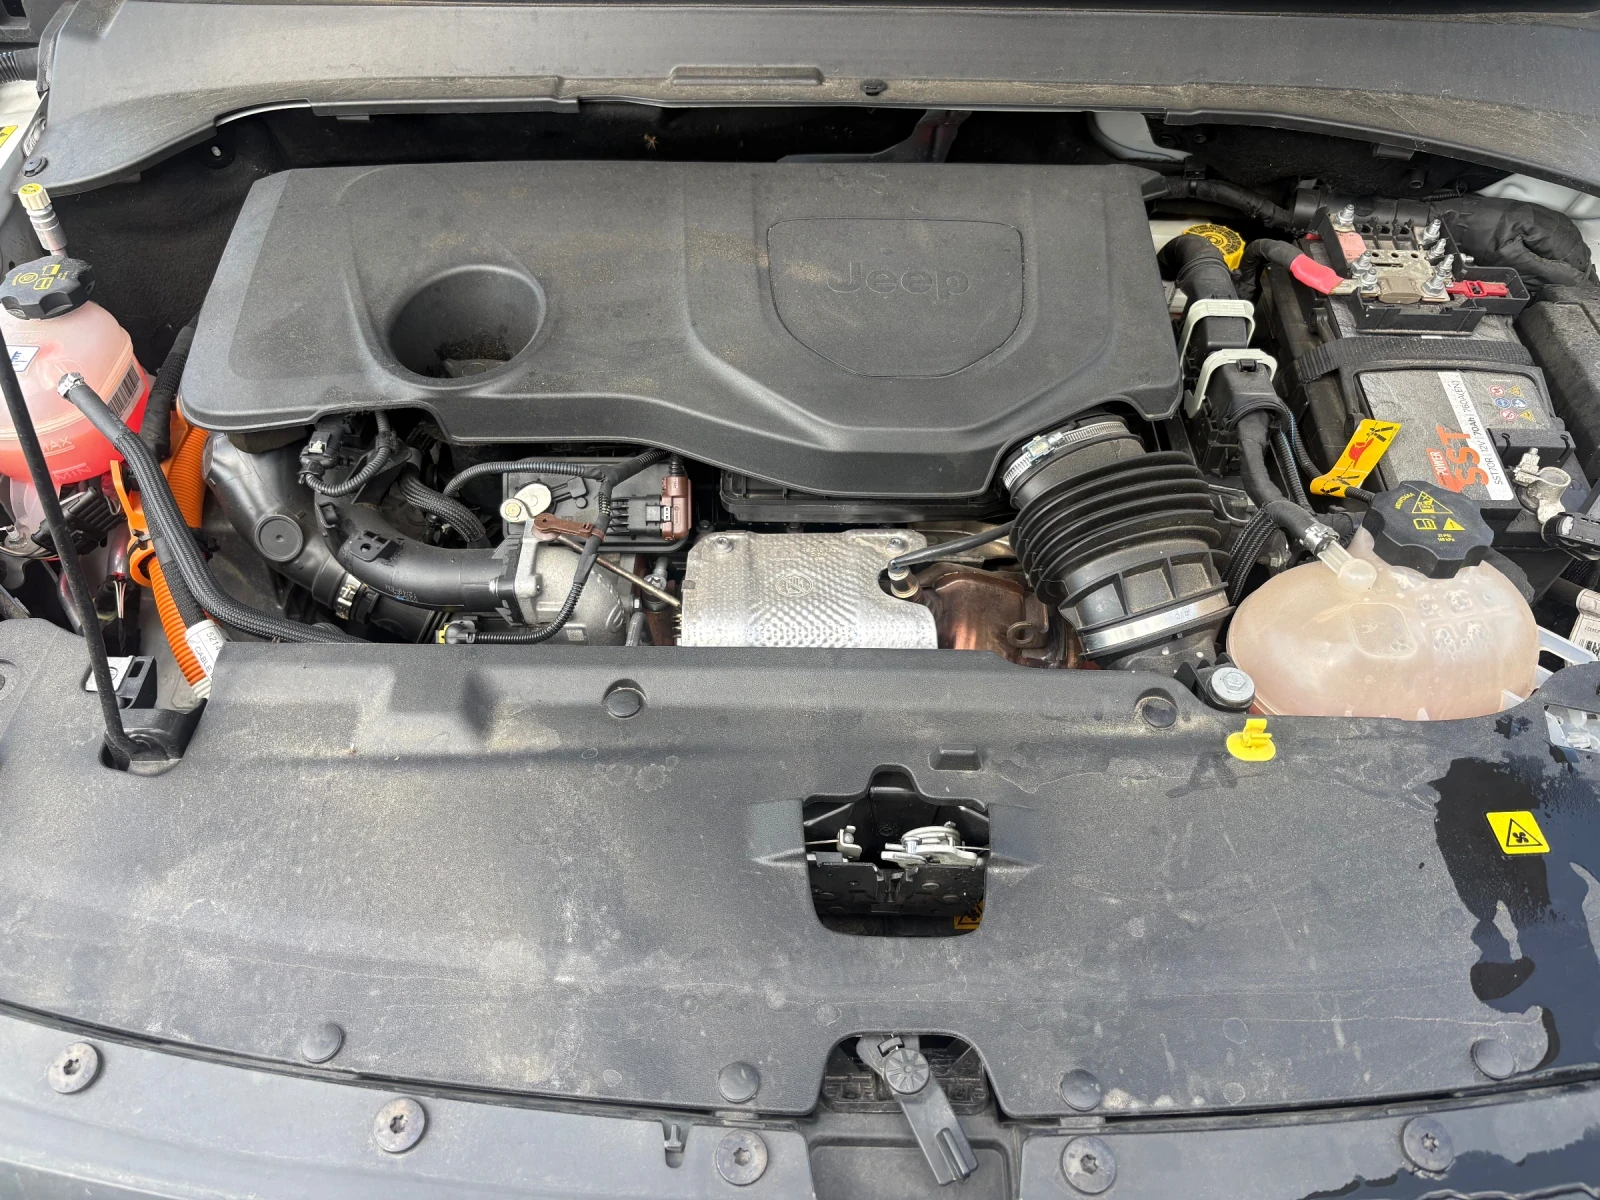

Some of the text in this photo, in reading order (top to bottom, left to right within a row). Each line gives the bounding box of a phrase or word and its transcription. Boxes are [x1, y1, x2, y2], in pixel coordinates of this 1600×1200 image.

[826, 261, 970, 300] Jeep
[1467, 417, 1480, 436] 70Ah
[1430, 451, 1448, 476] POWER
[1436, 425, 1488, 485] SST
[53, 465, 92, 480] MIN
[194, 645, 213, 673] CABLE
